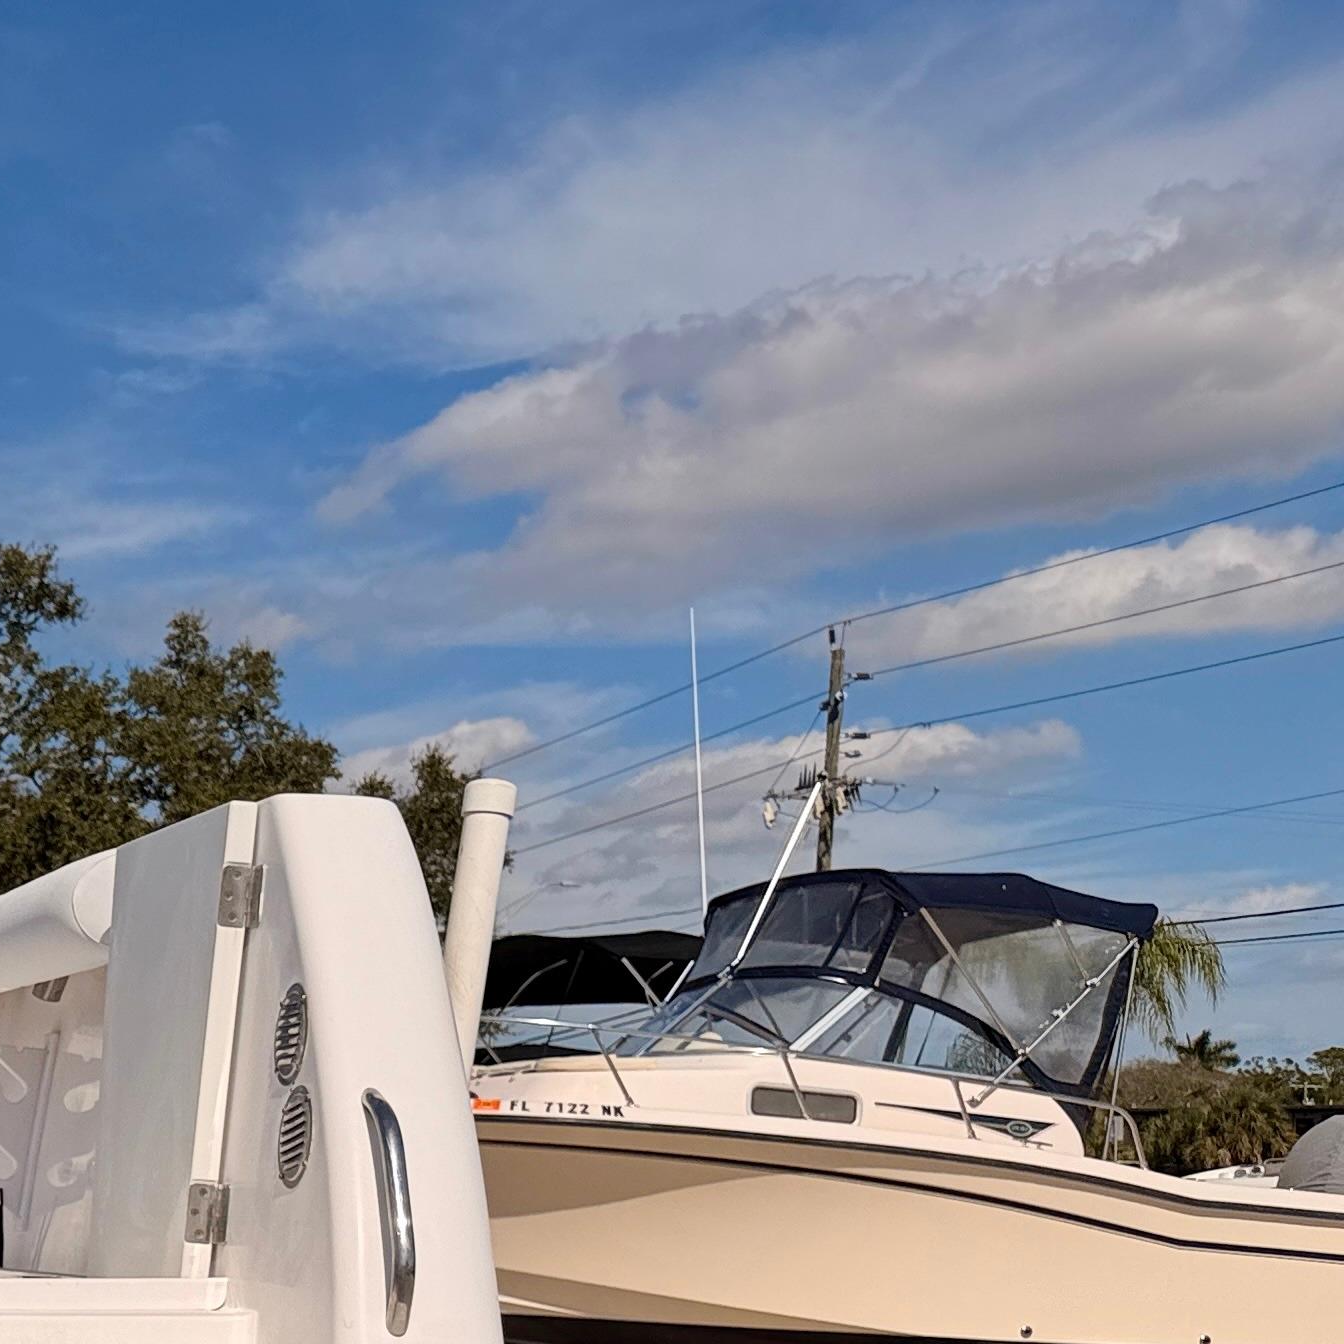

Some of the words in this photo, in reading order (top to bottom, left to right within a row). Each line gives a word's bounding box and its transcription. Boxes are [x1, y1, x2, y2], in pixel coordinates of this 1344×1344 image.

[510, 1101, 529, 1111] FL
[545, 1102, 589, 1114] 7122
[602, 1105, 624, 1117] NK
